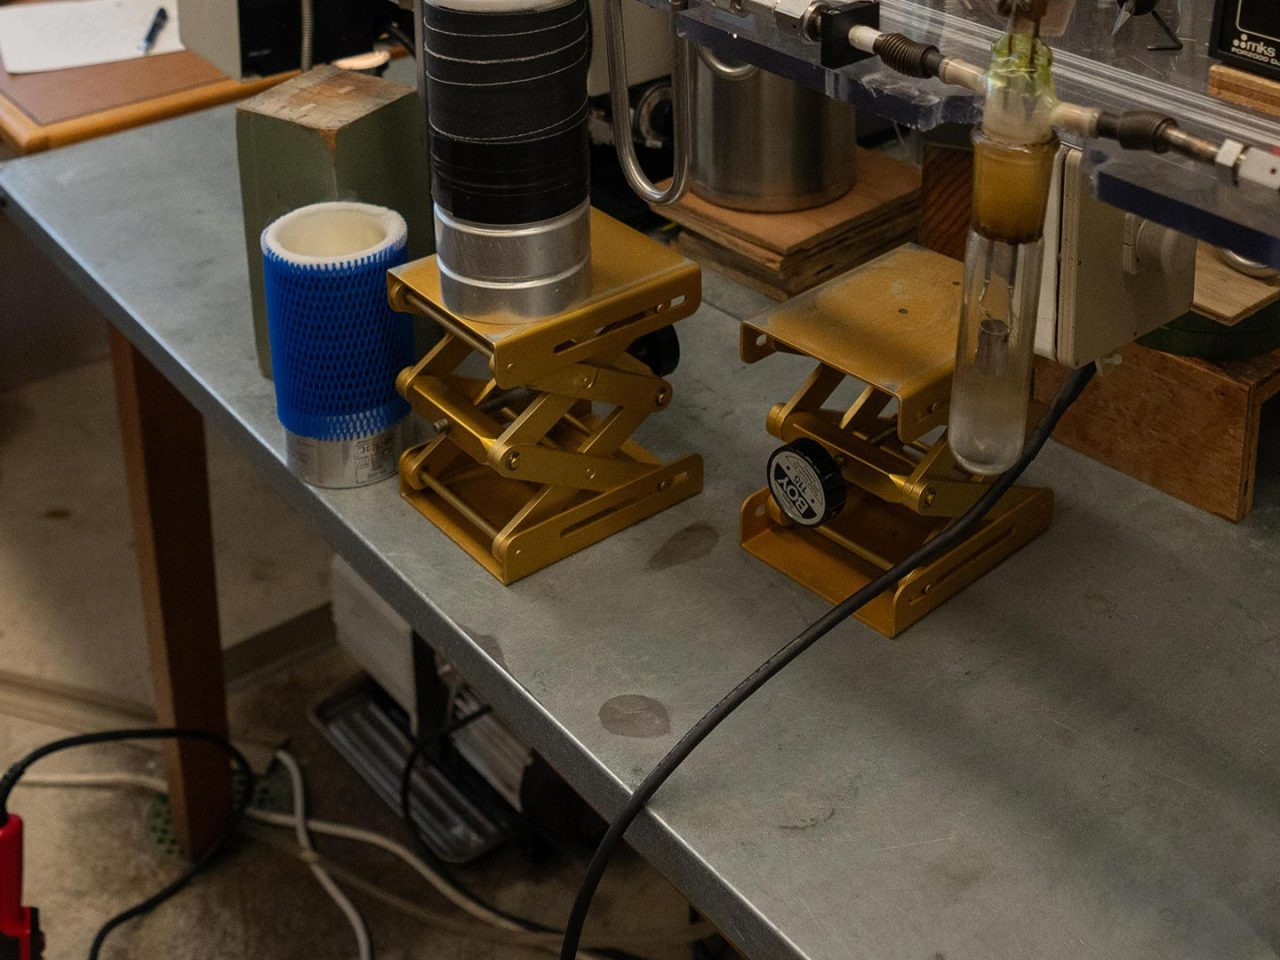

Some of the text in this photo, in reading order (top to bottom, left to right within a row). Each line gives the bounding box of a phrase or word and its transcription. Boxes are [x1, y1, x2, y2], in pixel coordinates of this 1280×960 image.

[1247, 39, 1276, 57] mks
[793, 475, 807, 494] 115
[777, 476, 809, 514] BOY
